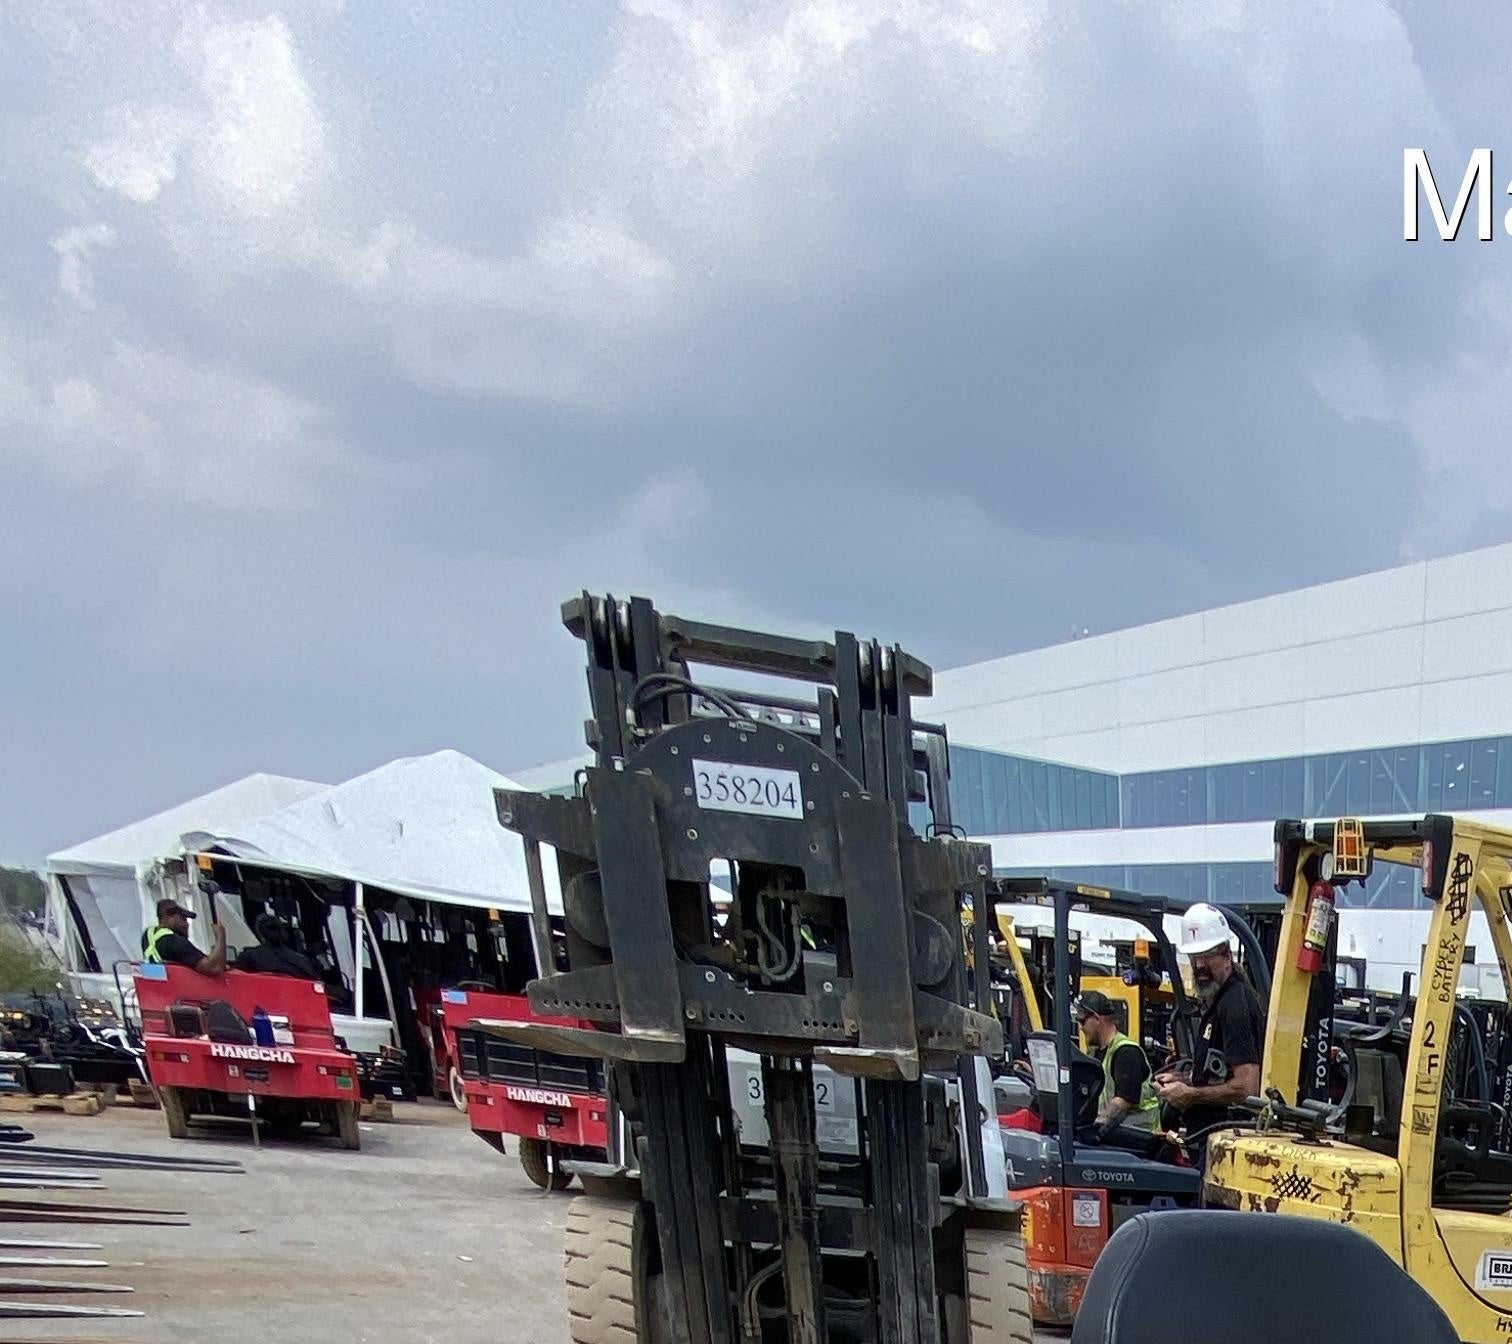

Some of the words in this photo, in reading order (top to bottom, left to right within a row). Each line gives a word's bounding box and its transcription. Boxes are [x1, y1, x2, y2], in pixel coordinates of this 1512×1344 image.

[698, 772, 797, 809] 358204
[1423, 1020, 1436, 1049] 2
[210, 1044, 296, 1064] HANGCHA
[1315, 1017, 1331, 1089] TOYOTA
[506, 1087, 573, 1108] HANGCHA
[1097, 1171, 1135, 1183] TOYOTA
